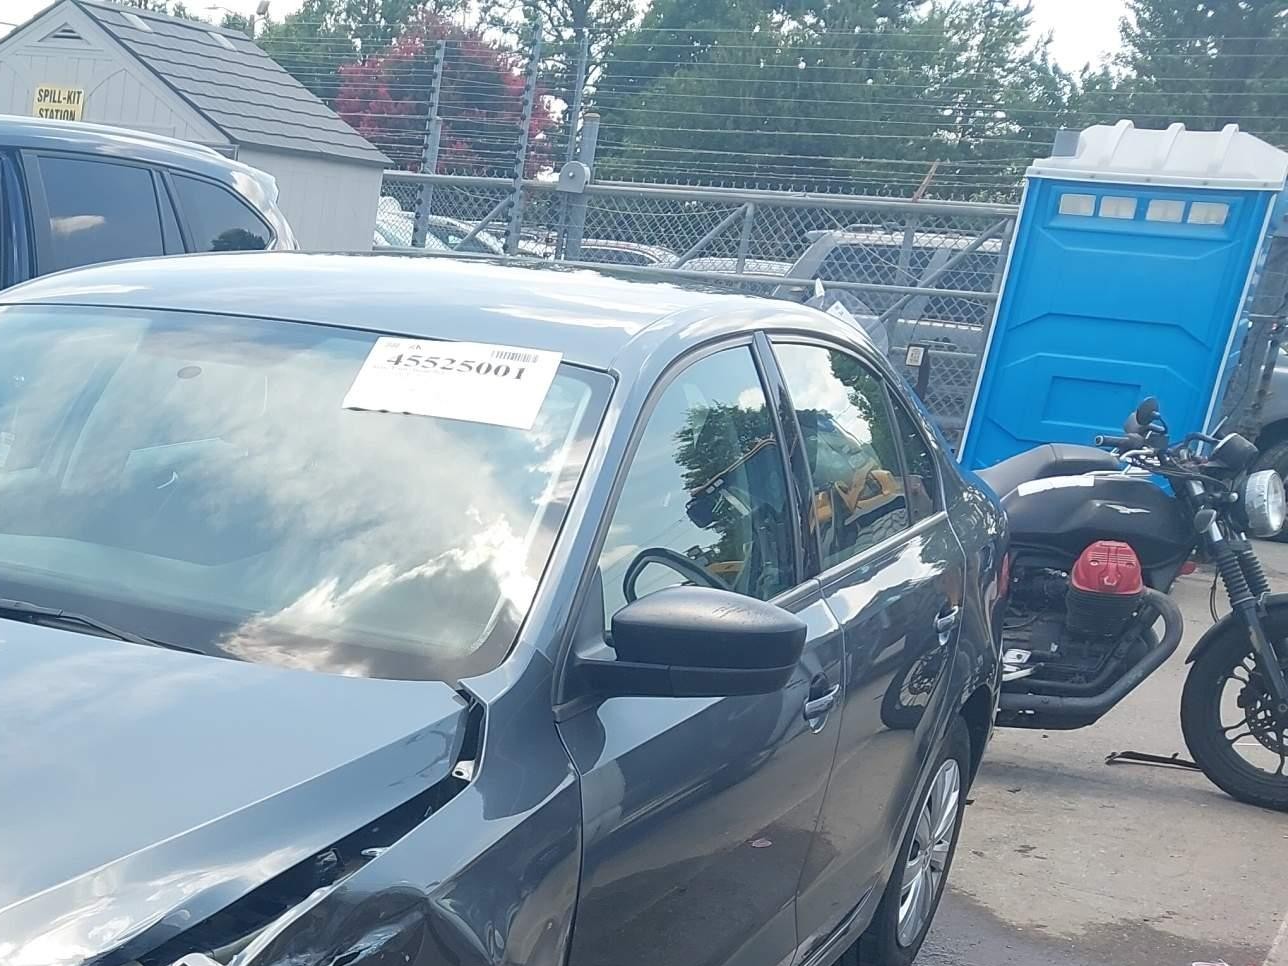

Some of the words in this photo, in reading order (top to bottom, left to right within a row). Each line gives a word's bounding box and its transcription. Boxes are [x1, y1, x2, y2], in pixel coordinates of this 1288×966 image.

[36, 88, 83, 105] SPILL-KIT
[38, 107, 76, 121] STATION
[386, 353, 526, 380] 45525001
